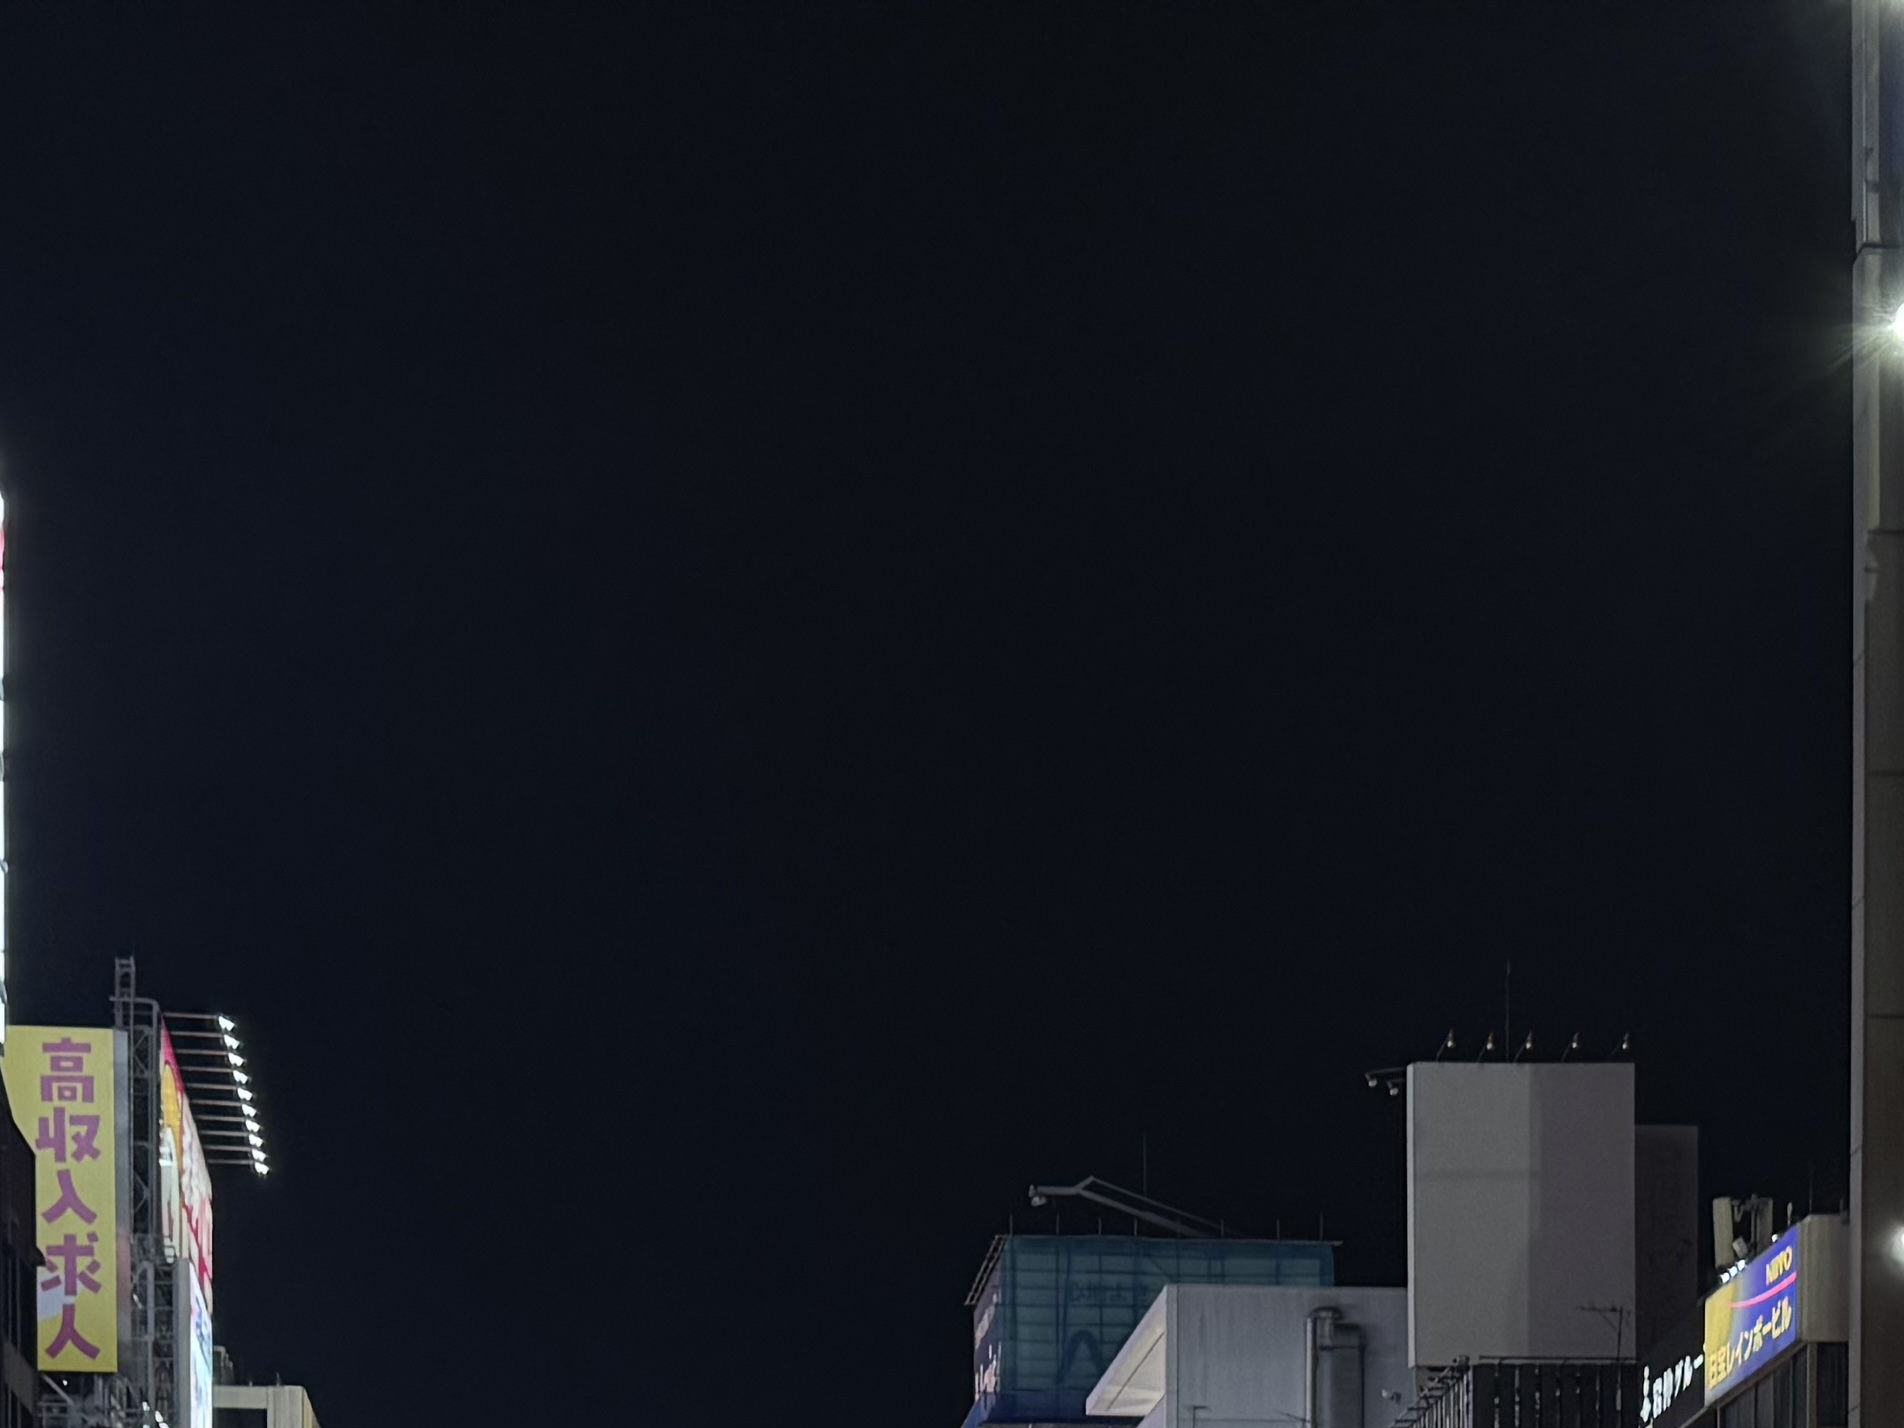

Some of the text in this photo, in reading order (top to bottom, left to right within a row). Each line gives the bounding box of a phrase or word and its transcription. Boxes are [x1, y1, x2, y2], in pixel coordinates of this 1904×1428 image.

[35, 1036, 101, 1361] 高収入求人
[1708, 1295, 1793, 1390] 日宝レインボービル
